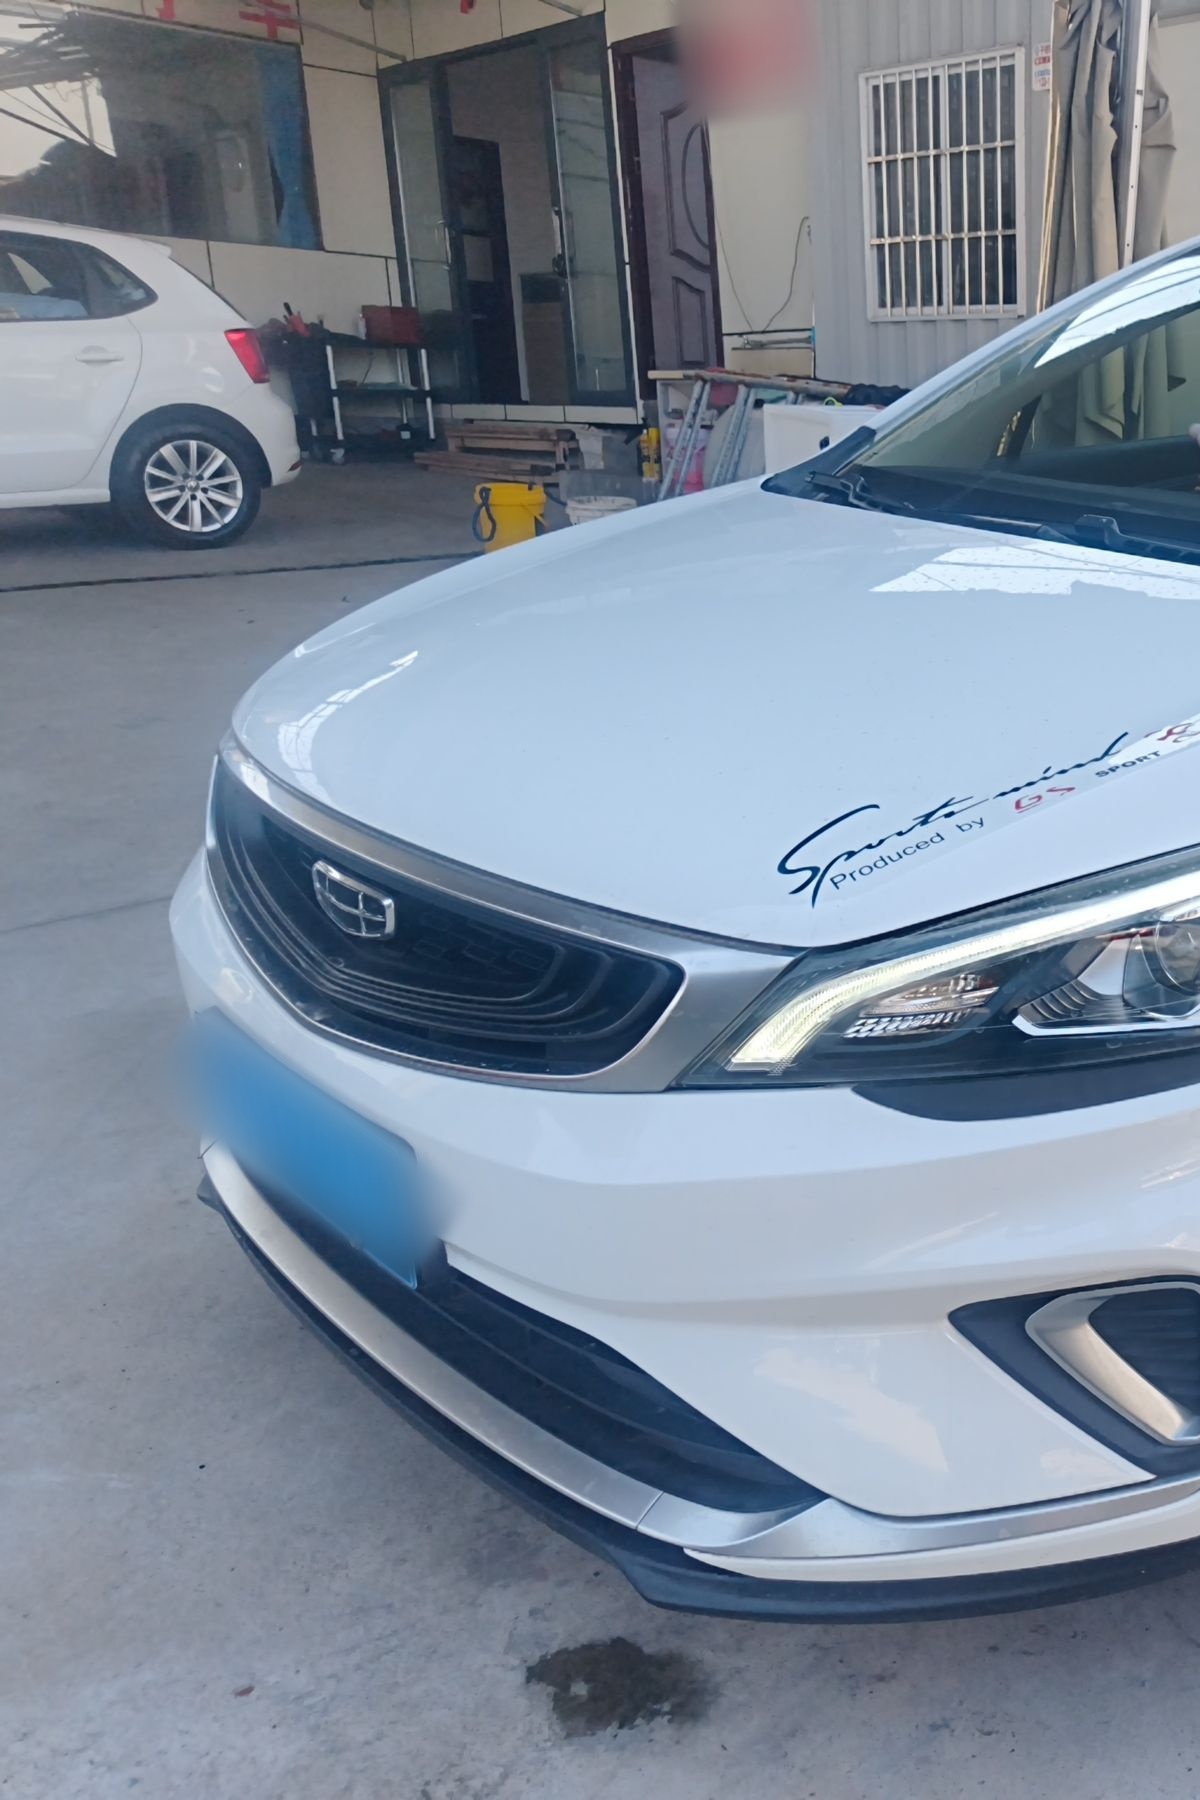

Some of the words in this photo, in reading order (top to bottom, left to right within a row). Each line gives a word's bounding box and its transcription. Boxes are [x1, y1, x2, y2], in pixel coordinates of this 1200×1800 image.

[829, 832, 945, 889] Produced
[955, 816, 985, 832] by
[1095, 750, 1160, 777] SPORT
